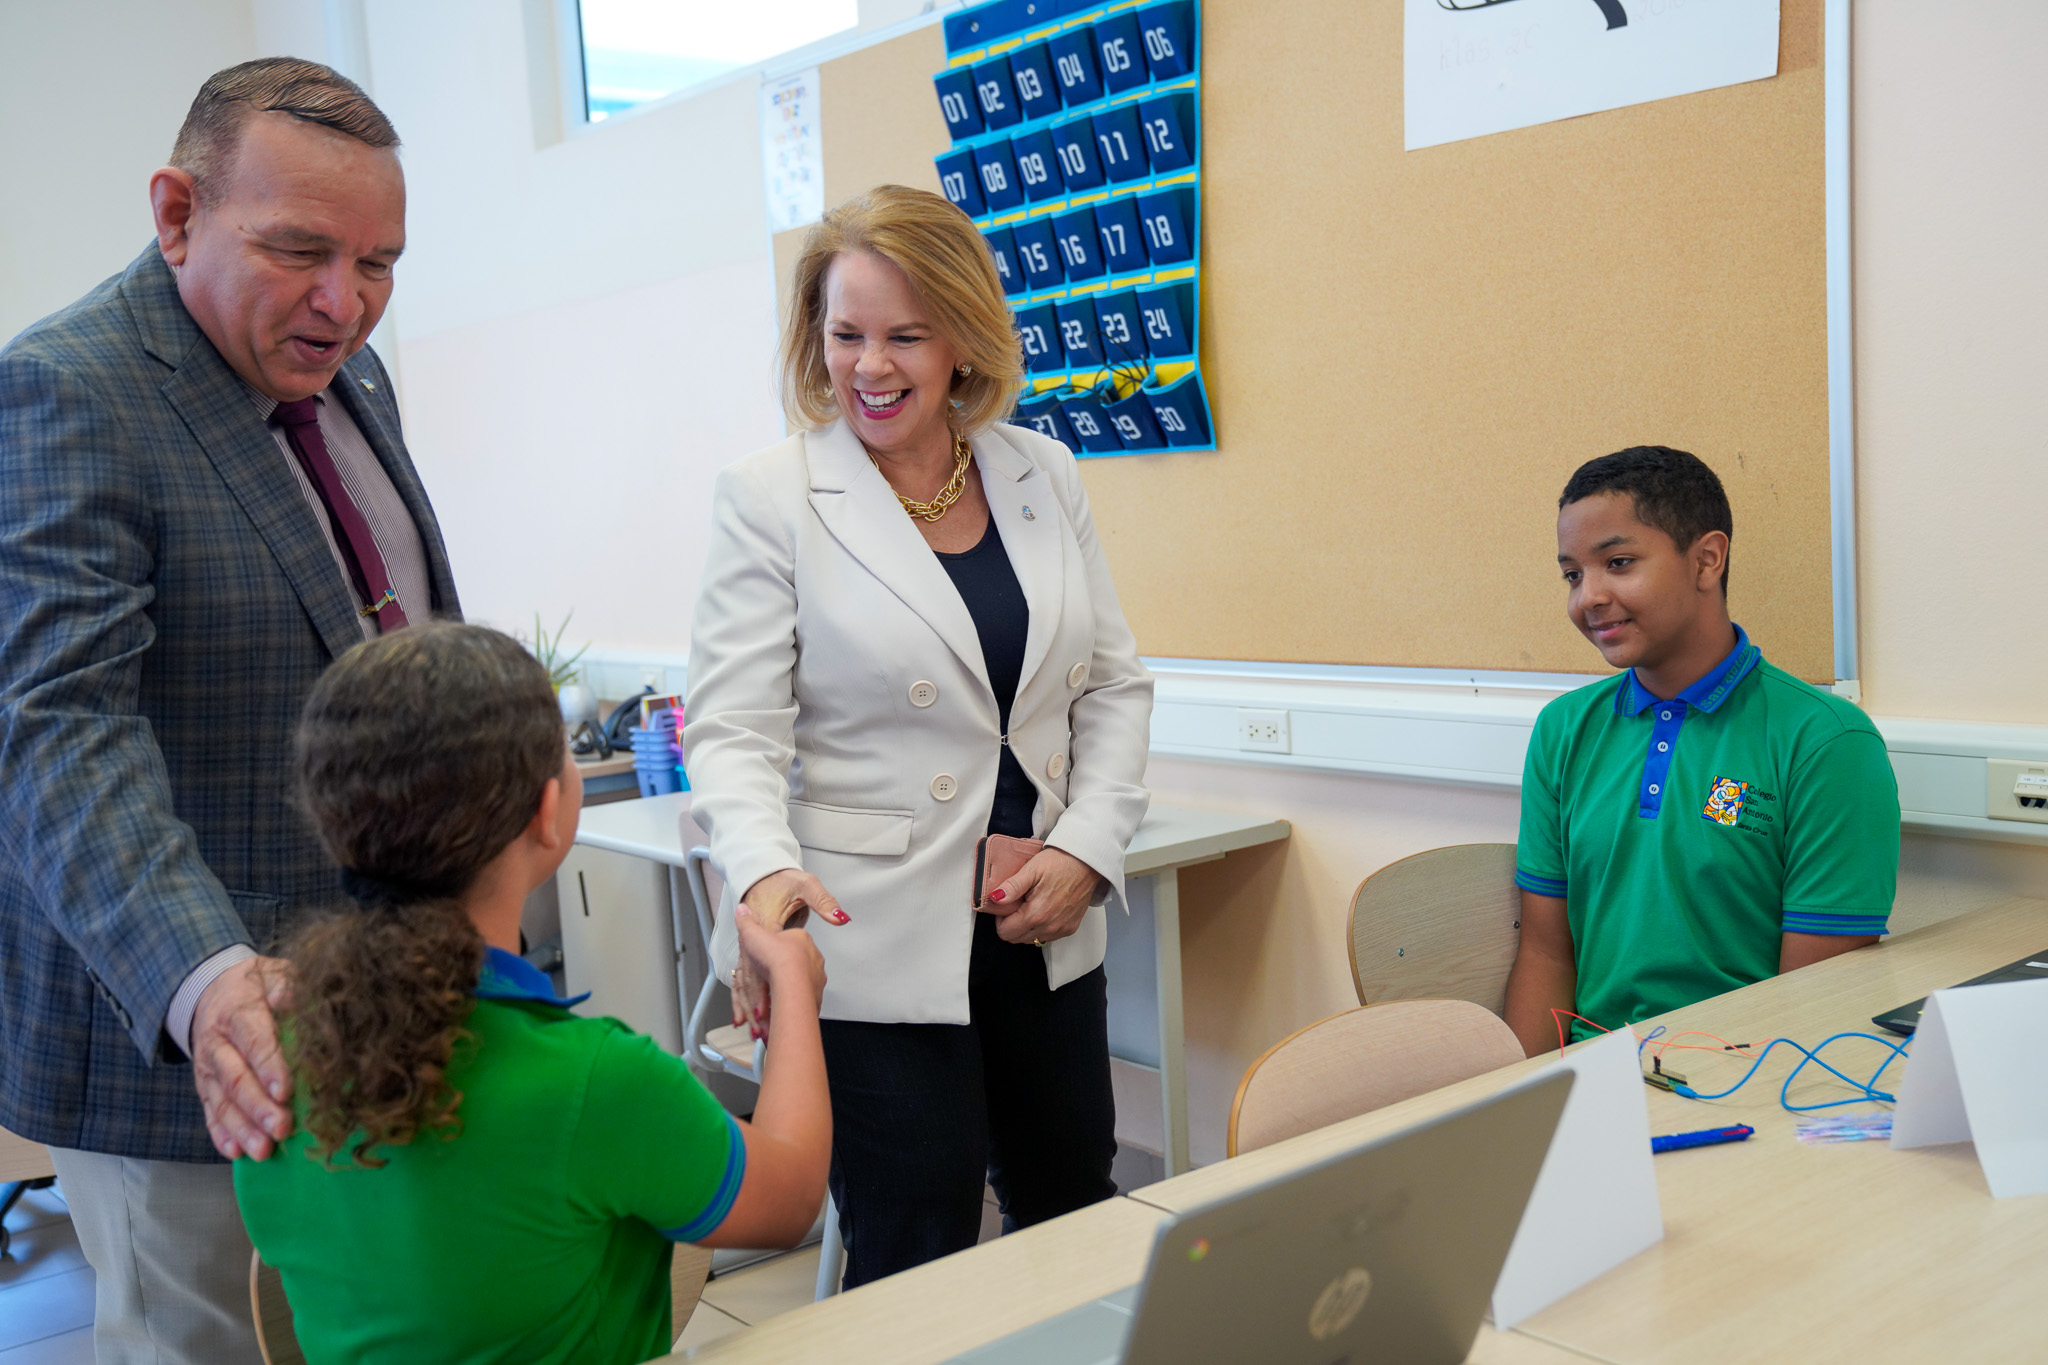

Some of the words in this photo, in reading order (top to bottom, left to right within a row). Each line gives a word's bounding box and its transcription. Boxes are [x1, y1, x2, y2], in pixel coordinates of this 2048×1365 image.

[942, 92, 968, 123] 01
[979, 82, 1004, 112] 02
[1017, 69, 1042, 100] 03
[1058, 54, 1084, 86] 04
[1103, 39, 1130, 72] 05
[1146, 28, 1174, 60] 06
[943, 172, 967, 202] 07
[982, 163, 1007, 192] 08
[1020, 154, 1047, 184] 09
[1058, 144, 1085, 175] 10
[1100, 132, 1128, 164] 11
[1146, 119, 1173, 152] 12
[1021, 243, 1048, 273] 15
[1060, 236, 1086, 265] 16
[1102, 225, 1125, 256] 17
[1146, 216, 1173, 248] 18
[1022, 325, 1048, 355] 21
[1062, 320, 1087, 350] 22
[1103, 313, 1130, 343] 23
[1144, 309, 1171, 339] 24
[1032, 414, 1058, 439] 27
[1070, 412, 1100, 435] 28
[1111, 416, 1141, 440] 29
[1156, 408, 1185, 432] 30
[1742, 807, 1773, 822] Antonio
[1748, 785, 1776, 802] Colegio
